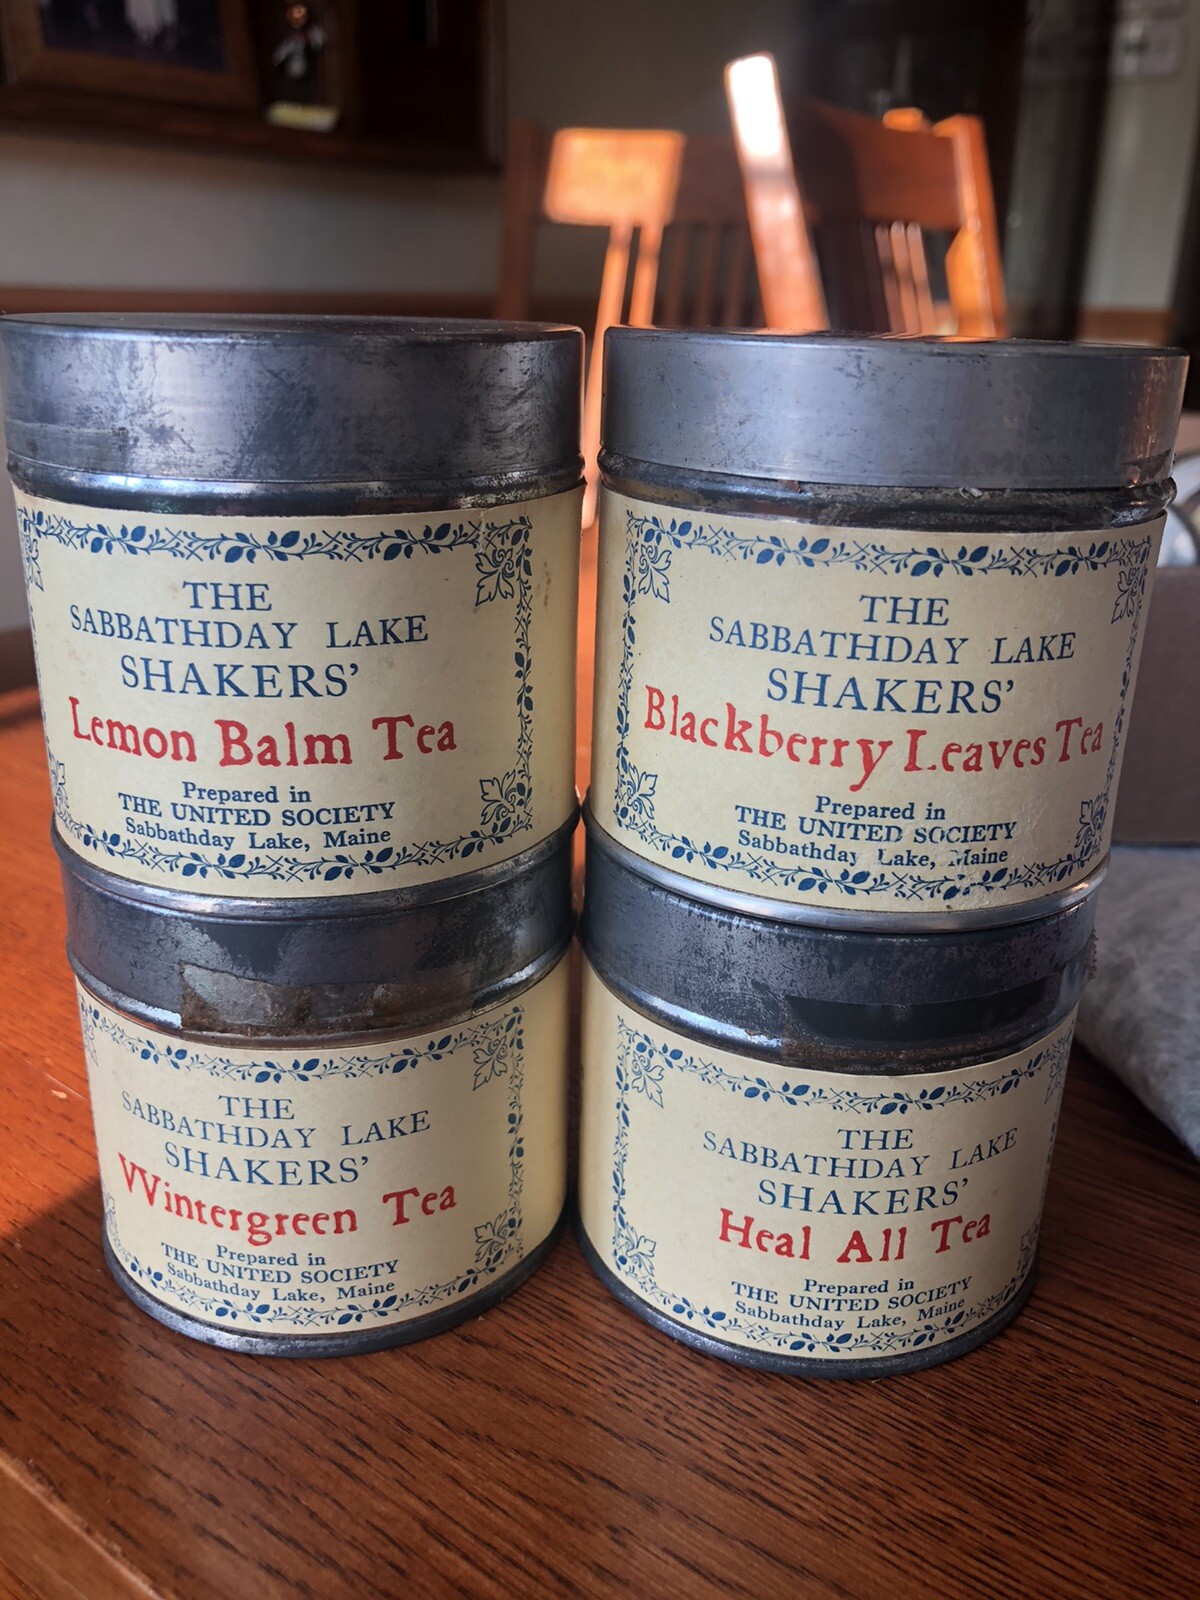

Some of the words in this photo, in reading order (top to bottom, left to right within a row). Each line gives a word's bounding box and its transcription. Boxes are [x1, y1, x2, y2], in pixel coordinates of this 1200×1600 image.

[182, 581, 272, 611] THE
[859, 594, 949, 626] THE
[70, 605, 298, 649] SABBATHDAY
[327, 615, 429, 648] LAKE
[709, 616, 968, 665] SABBATHDAY
[990, 632, 1076, 664] LAKE
[68, 696, 197, 762] Lemon
[214, 719, 352, 767] Balm
[372, 714, 457, 761] Tea
[644, 685, 892, 792] Blackberry
[904, 728, 1046, 772] Leaves
[1056, 717, 1103, 763] Tea
[118, 792, 162, 817] THE
[171, 803, 271, 826] UNITED
[282, 801, 396, 826] SOCIETY
[182, 781, 279, 803] Prepared
[290, 785, 311, 803] in
[816, 795, 915, 820] Prepared
[925, 802, 946, 820] in
[126, 817, 235, 850] Sabbathday
[249, 832, 311, 852] Lake,
[324, 828, 391, 848] Maine
[735, 804, 786, 831] THE
[799, 817, 903, 843] UNITED
[914, 821, 1017, 843] SOCIETY
[738, 830, 859, 866] Sabbathday
[878, 848, 936, 869] Lake,
[121, 1090, 316, 1149] SABBATHDAY
[341, 1110, 431, 1146] LAKE
[218, 1095, 295, 1120] THE
[703, 1131, 930, 1179] SABBATHDAY
[949, 1127, 1018, 1171] LAKE
[837, 1128, 913, 1150] THE
[118, 1152, 358, 1247] Wintergreen
[382, 1185, 457, 1226] Tea
[718, 1207, 812, 1260] Heal
[837, 1226, 907, 1263] All
[931, 1213, 991, 1254] Tea
[161, 1242, 197, 1268] THE
[207, 1258, 291, 1284] UNITED
[300, 1259, 399, 1284] SOCIETY
[216, 1244, 298, 1267] Prepared
[307, 1253, 325, 1266] in
[167, 1262, 260, 1301] Sabbathday
[273, 1287, 325, 1304] Lake,
[337, 1281, 395, 1300] Maine
[732, 1280, 778, 1305] THE
[789, 1296, 879, 1312] UNITED
[888, 1276, 972, 1310] SOCIETY
[804, 1278, 889, 1296] Prepared
[897, 1278, 914, 1291] in
[735, 1300, 844, 1331] Sabbathday
[857, 1315, 906, 1329] Lake,
[917, 1298, 965, 1321] Maine
